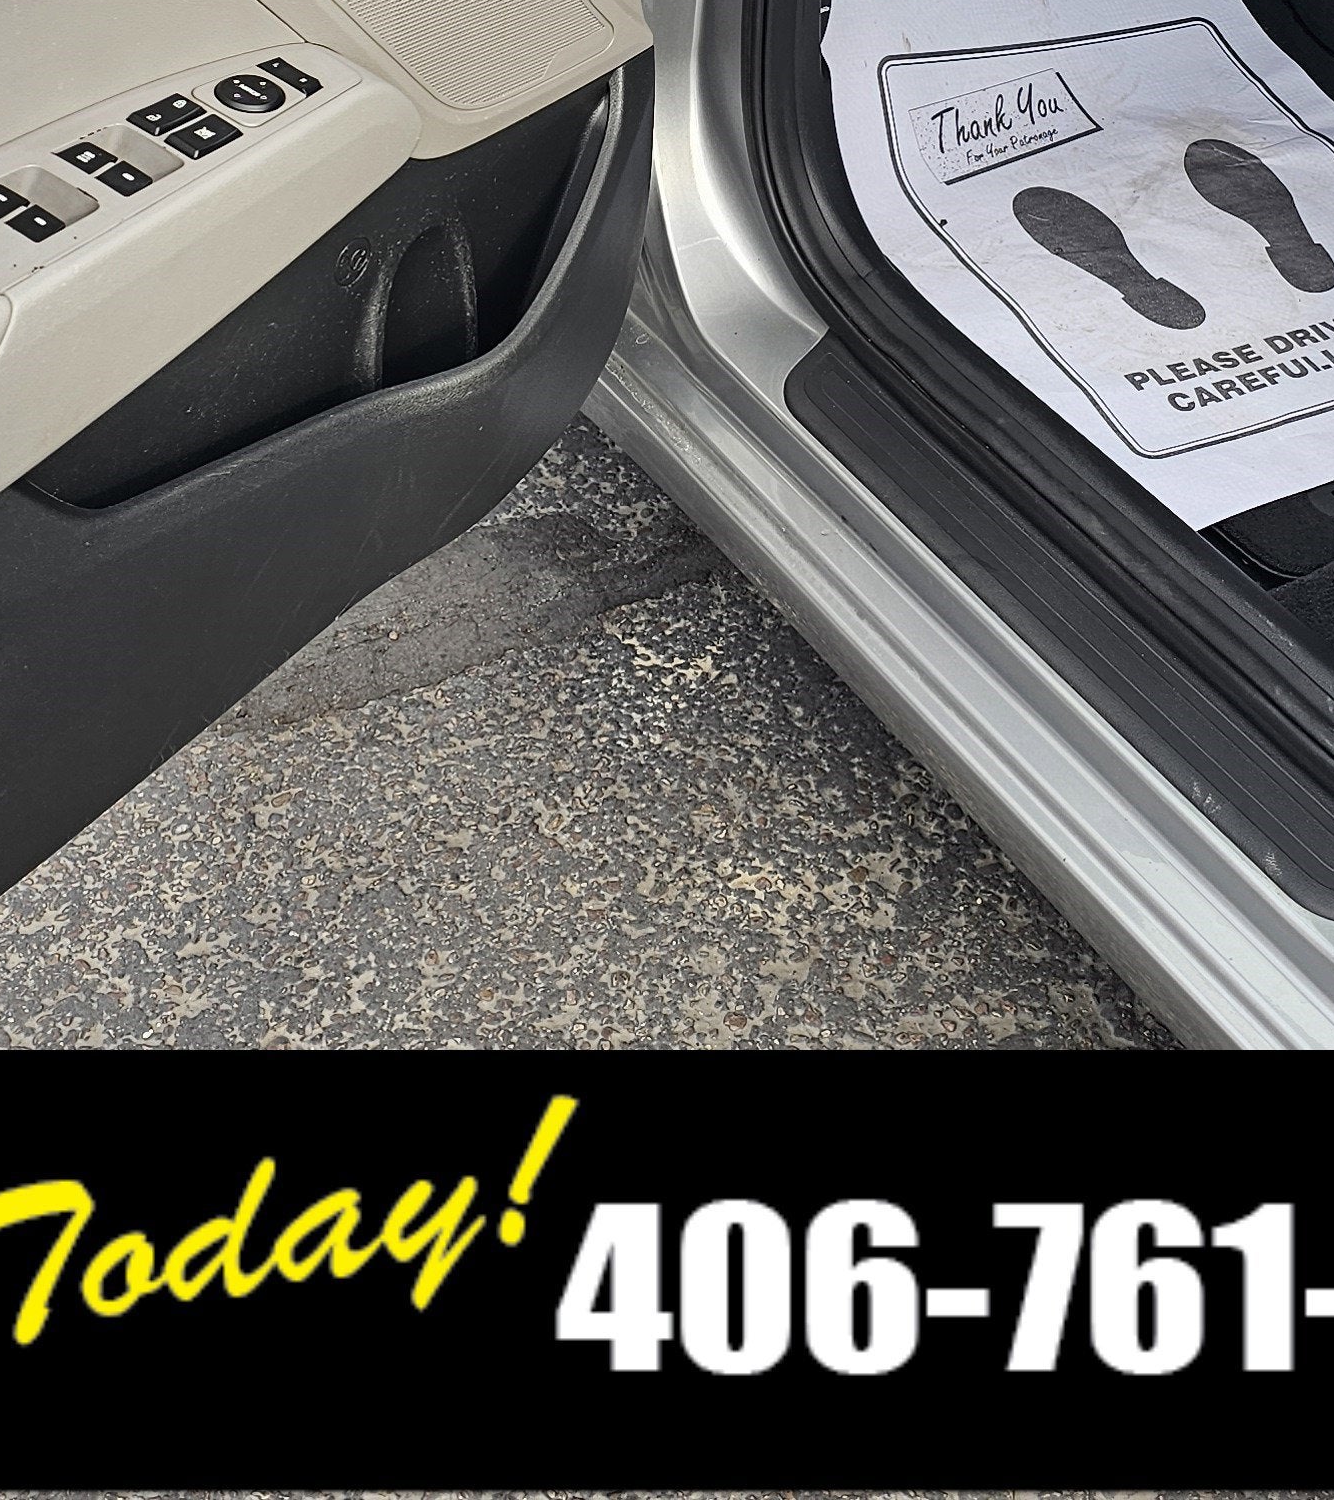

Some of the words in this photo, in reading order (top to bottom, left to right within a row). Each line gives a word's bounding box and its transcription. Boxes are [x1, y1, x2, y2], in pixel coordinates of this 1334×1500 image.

[930, 93, 1013, 154] Thank
[1017, 82, 1064, 125] You
[966, 149, 984, 165] For
[1010, 128, 1059, 150] Patronage
[1124, 343, 1264, 391] PLEASE
